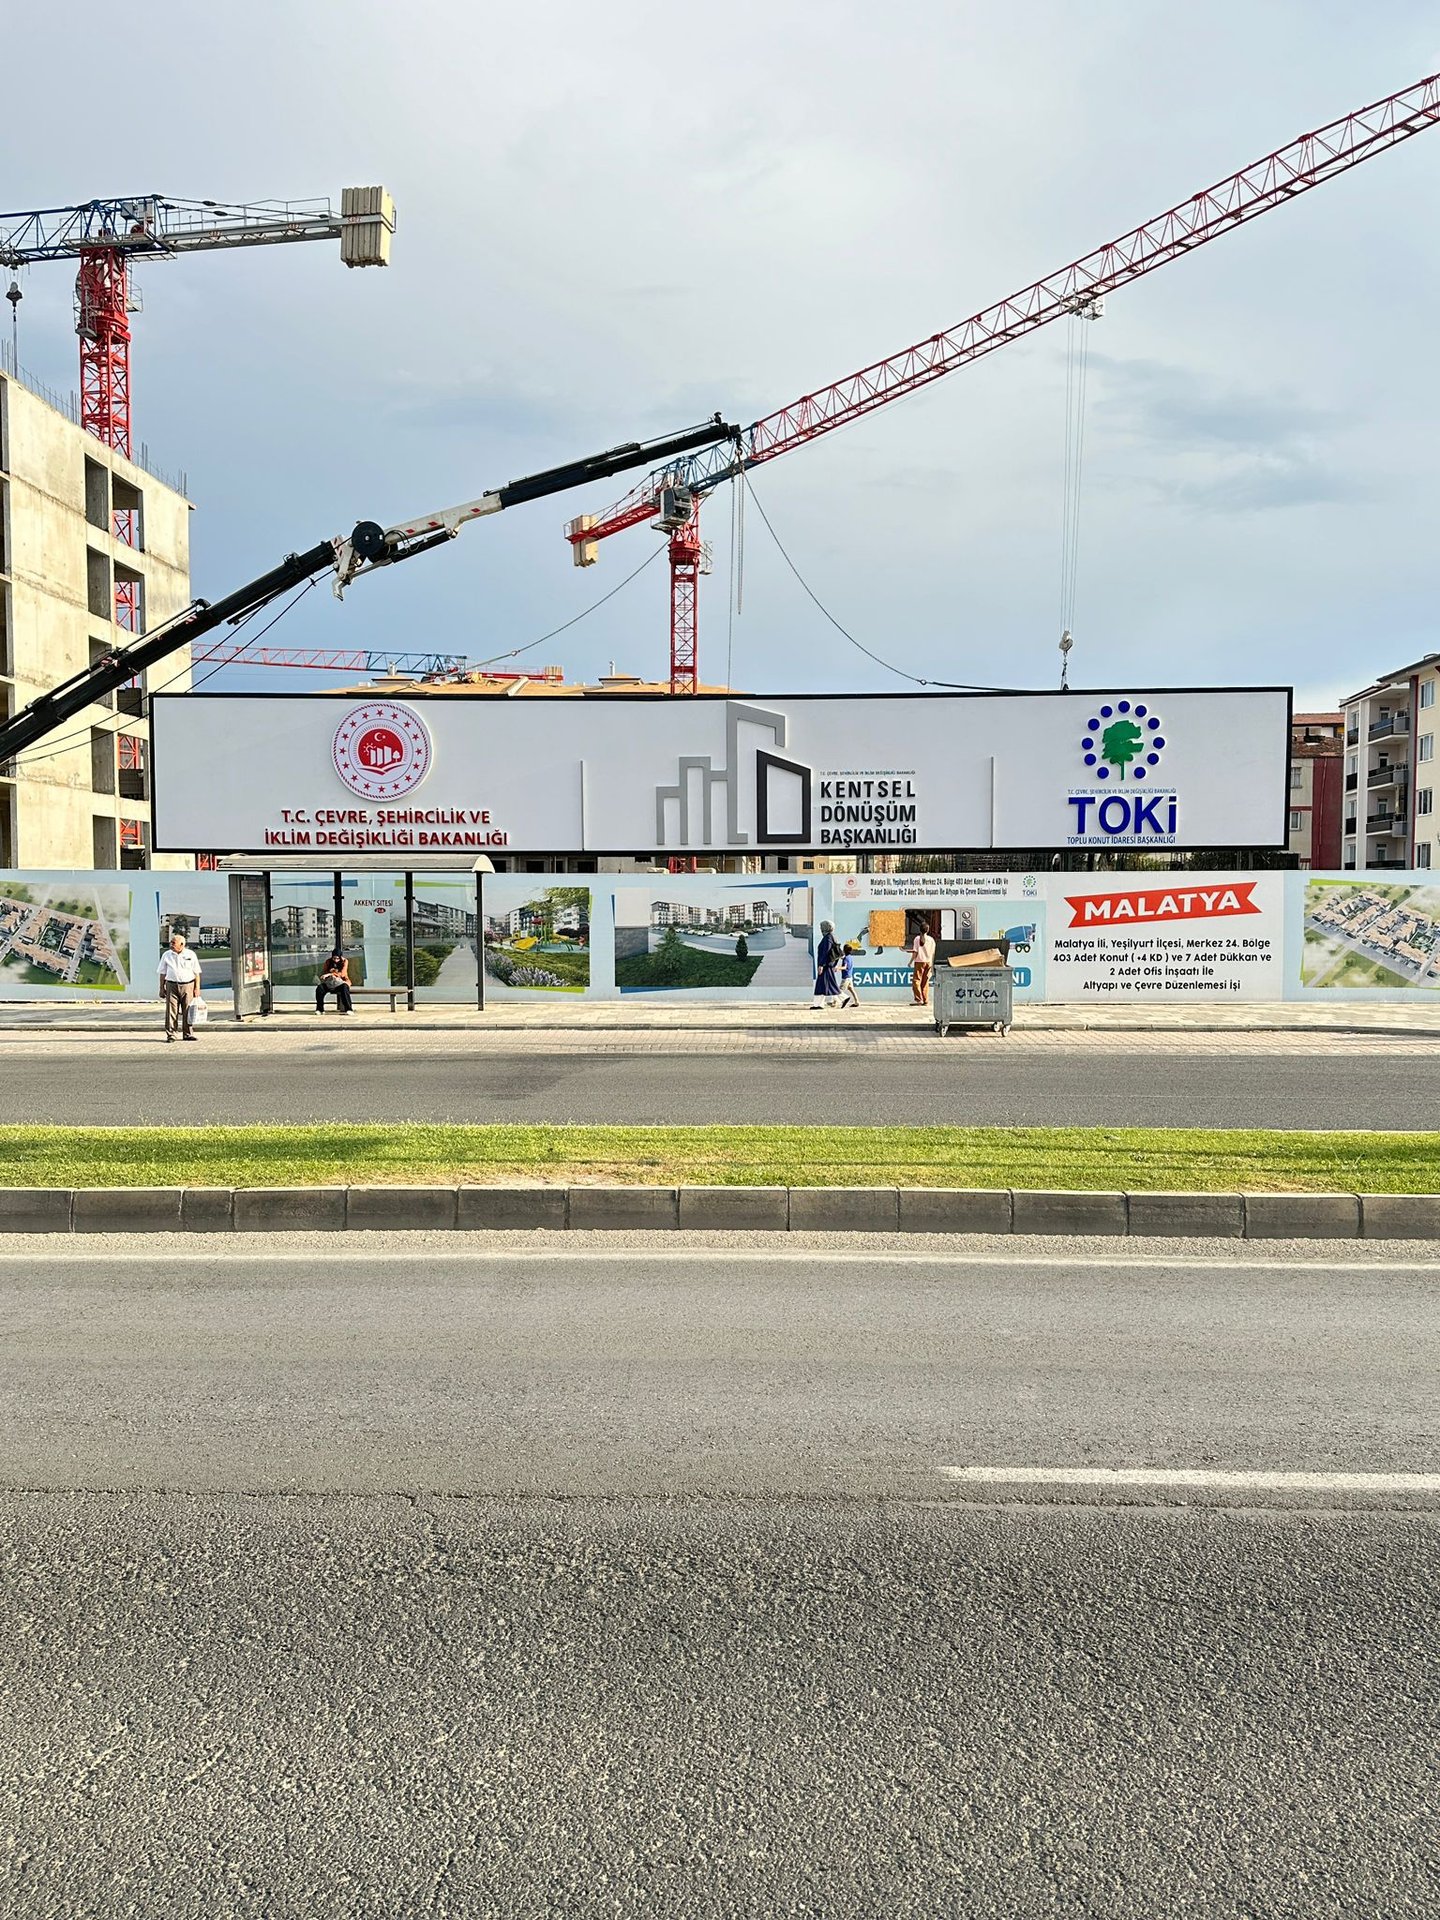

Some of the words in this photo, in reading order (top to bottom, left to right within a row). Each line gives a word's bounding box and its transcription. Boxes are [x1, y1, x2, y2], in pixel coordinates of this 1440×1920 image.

[821, 781, 915, 798] KENTSEL
[281, 810, 311, 823] T.C.
[315, 810, 373, 826] ÇEVRE,
[377, 808, 465, 826] ŞEHİRCİLİK
[470, 810, 490, 823] VE
[821, 801, 916, 827] DÖNÜŞÜM
[265, 829, 311, 845] İKLİM
[316, 828, 413, 848] DEĞİŞİKLİĞİ
[419, 829, 508, 845] BAKANLIĞI
[821, 824, 916, 848] BAŞKANLIĞI
[1137, 835, 1176, 845] BAŞKANLIĞI
[1084, 890, 1241, 921] MALATYA
[1055, 939, 1094, 950] Malatya
[1097, 938, 1108, 949] İli,
[1111, 939, 1154, 950] Yeşilyurt
[1156, 938, 1184, 950] İlçesi,
[1187, 939, 1223, 948] Merkez
[1226, 939, 1240, 948] 24.
[1242, 938, 1270, 950] Bölge
[1053, 953, 1072, 962] 403
[1074, 953, 1097, 962] Adet
[1100, 953, 1129, 962] Konut
[1150, 953, 1162, 962] KD
[1186, 953, 1191, 962] 7
[1194, 953, 1217, 962] Adet
[1220, 953, 1258, 962] Dükkan
[1110, 967, 1115, 976] 2
[1118, 967, 1141, 976] Adet
[1144, 967, 1162, 976] Ofis
[1165, 965, 1200, 978] İnşaatı
[1202, 965, 1214, 976] İle
[1083, 981, 1118, 992] Altyapı
[1134, 981, 1162, 992] Çevre
[1165, 981, 1227, 990] Düzenlemesi
[1229, 980, 1241, 991] İşi
